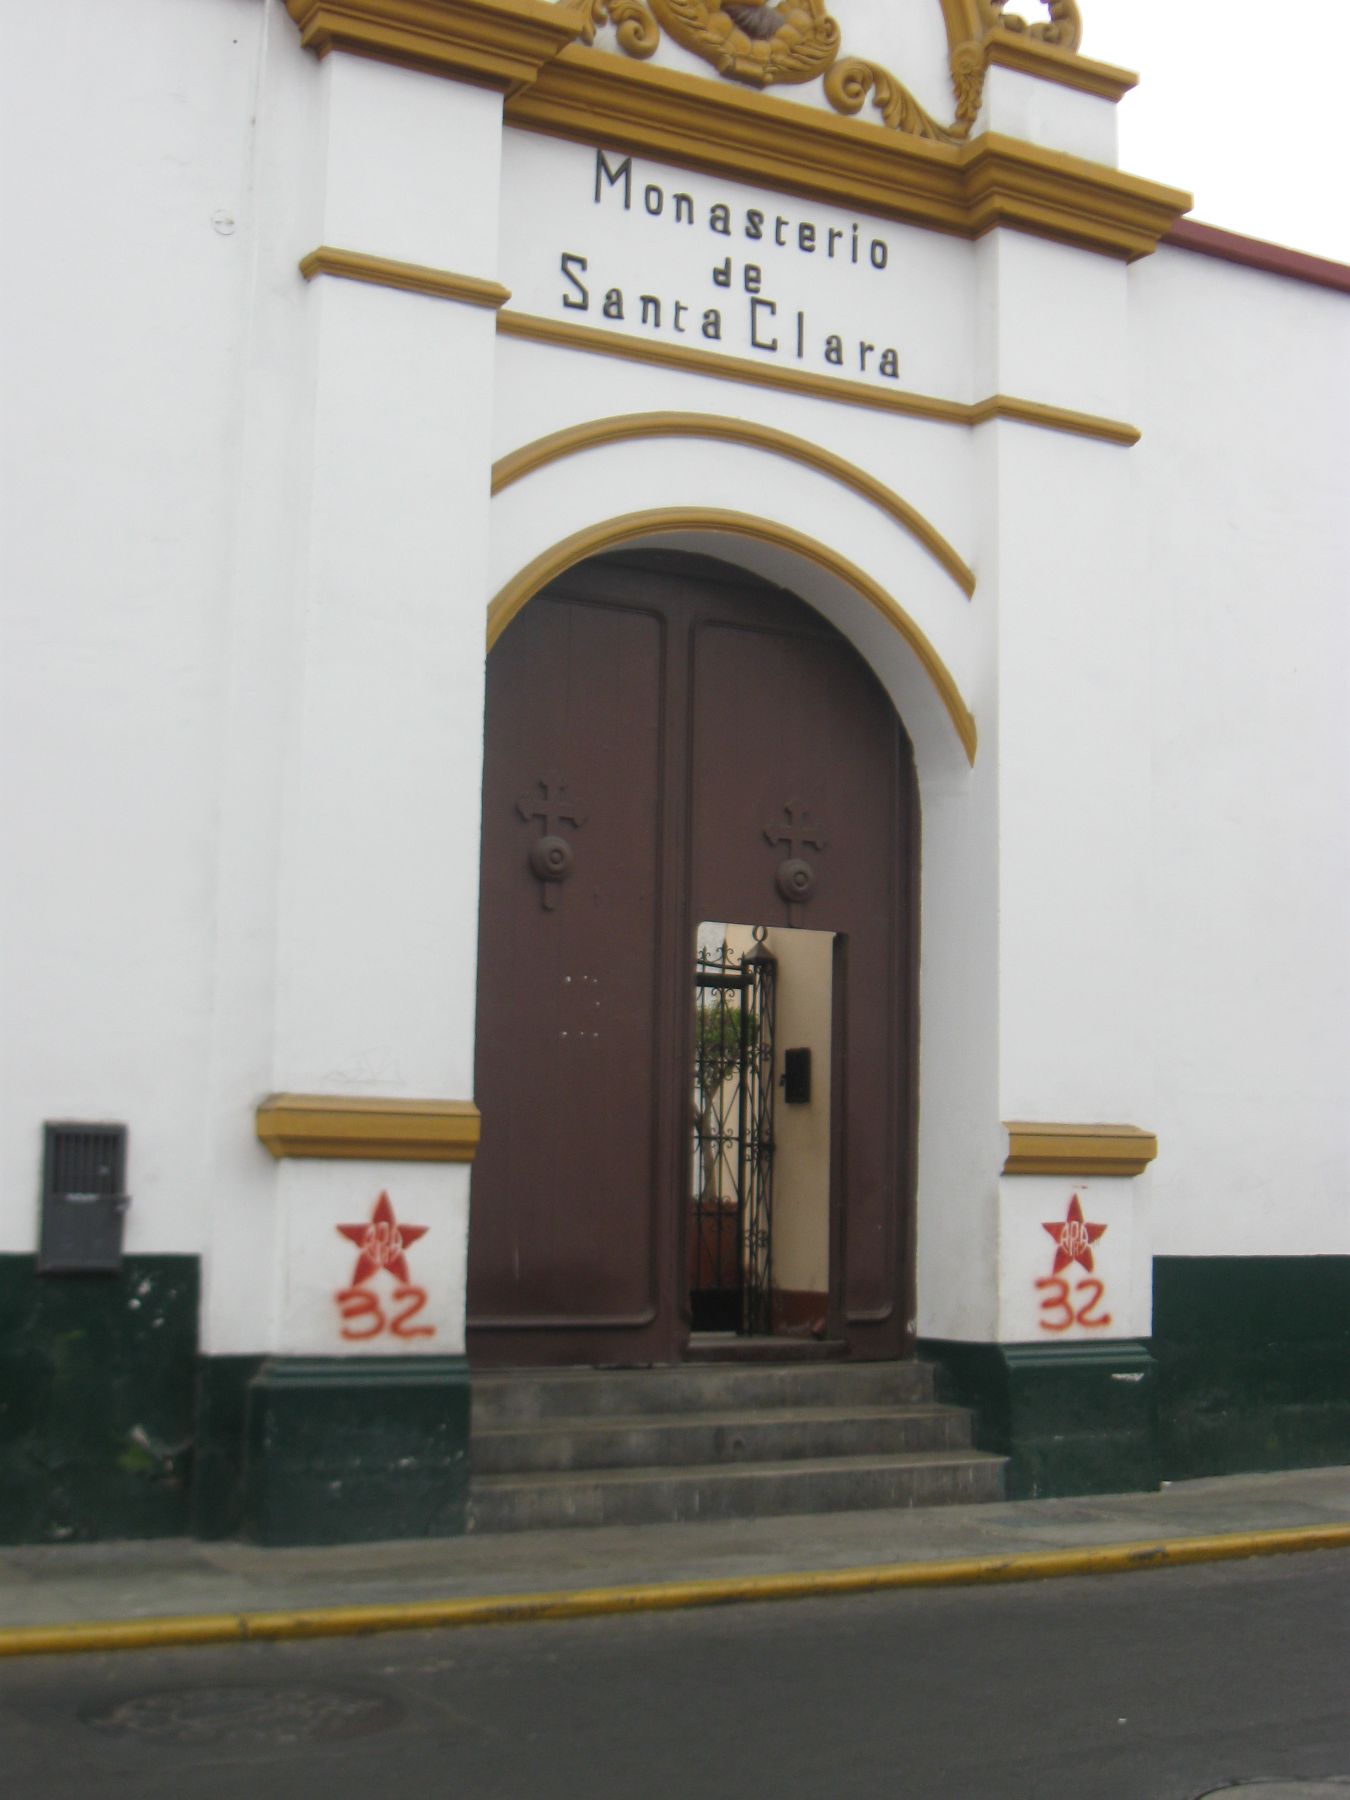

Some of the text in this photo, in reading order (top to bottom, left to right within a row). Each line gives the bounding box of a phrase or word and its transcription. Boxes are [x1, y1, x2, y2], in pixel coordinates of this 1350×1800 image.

[594, 148, 889, 270] Monasterio
[712, 256, 762, 294] de
[560, 251, 900, 379] Santa Clara
[334, 1286, 438, 1342] 32
[1034, 1276, 1112, 1332] 32
